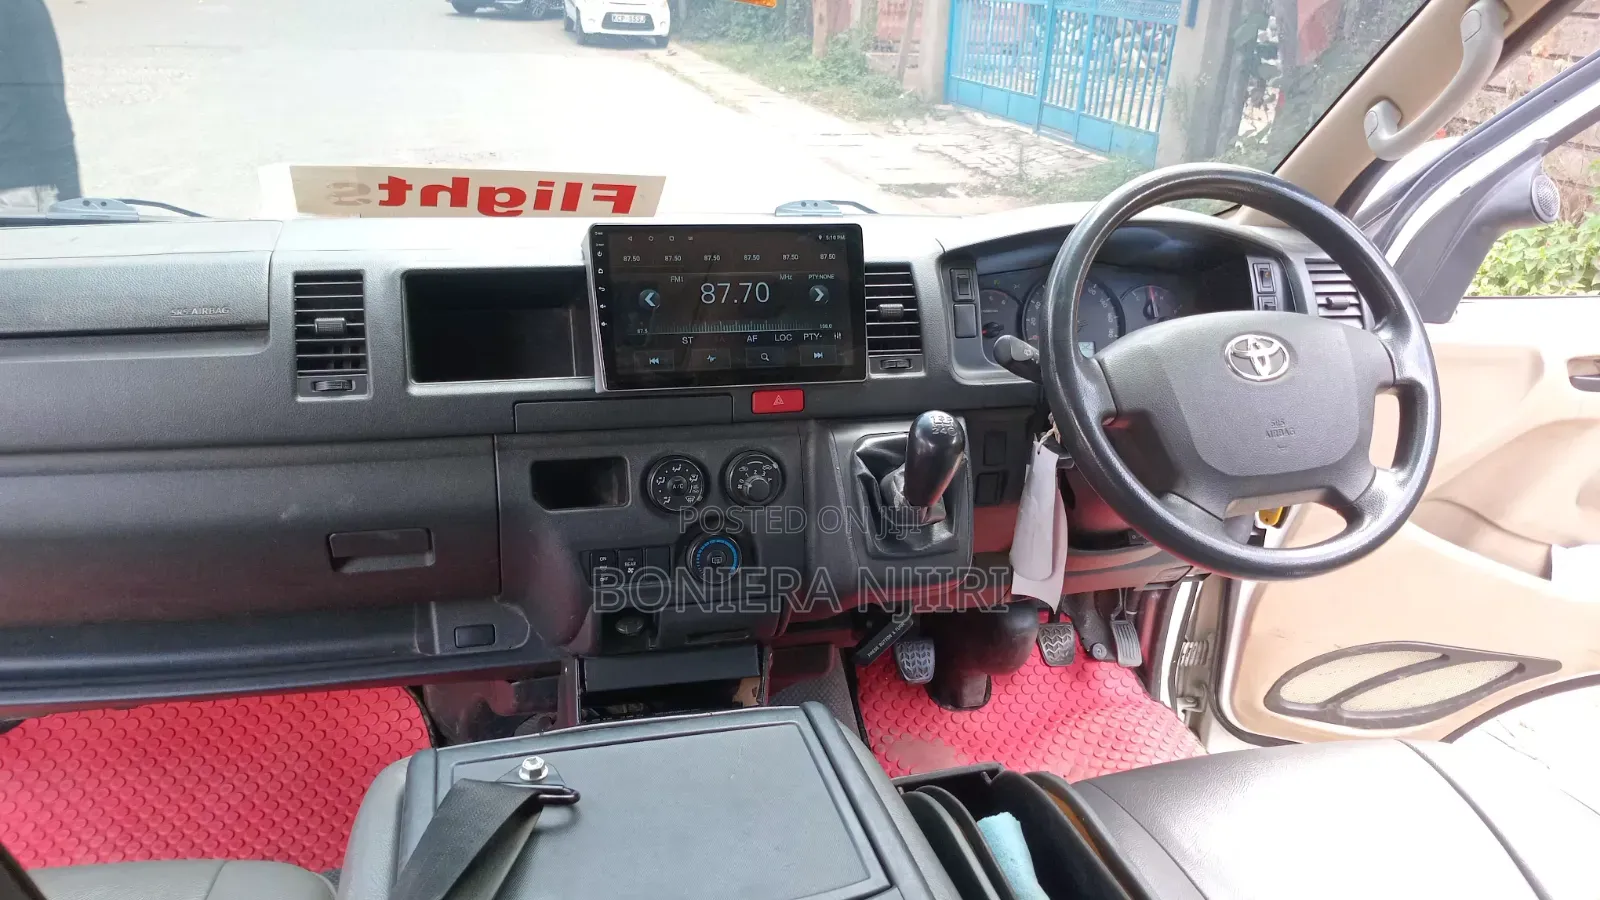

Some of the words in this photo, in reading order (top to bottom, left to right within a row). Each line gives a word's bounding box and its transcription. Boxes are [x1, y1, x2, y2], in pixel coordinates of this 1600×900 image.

[782, 253, 799, 261] 87.50
[700, 282, 770, 304] 87.70
[191, 307, 230, 315] AIRBAG
[682, 336, 693, 344] ST
[774, 334, 792, 342] LOC
